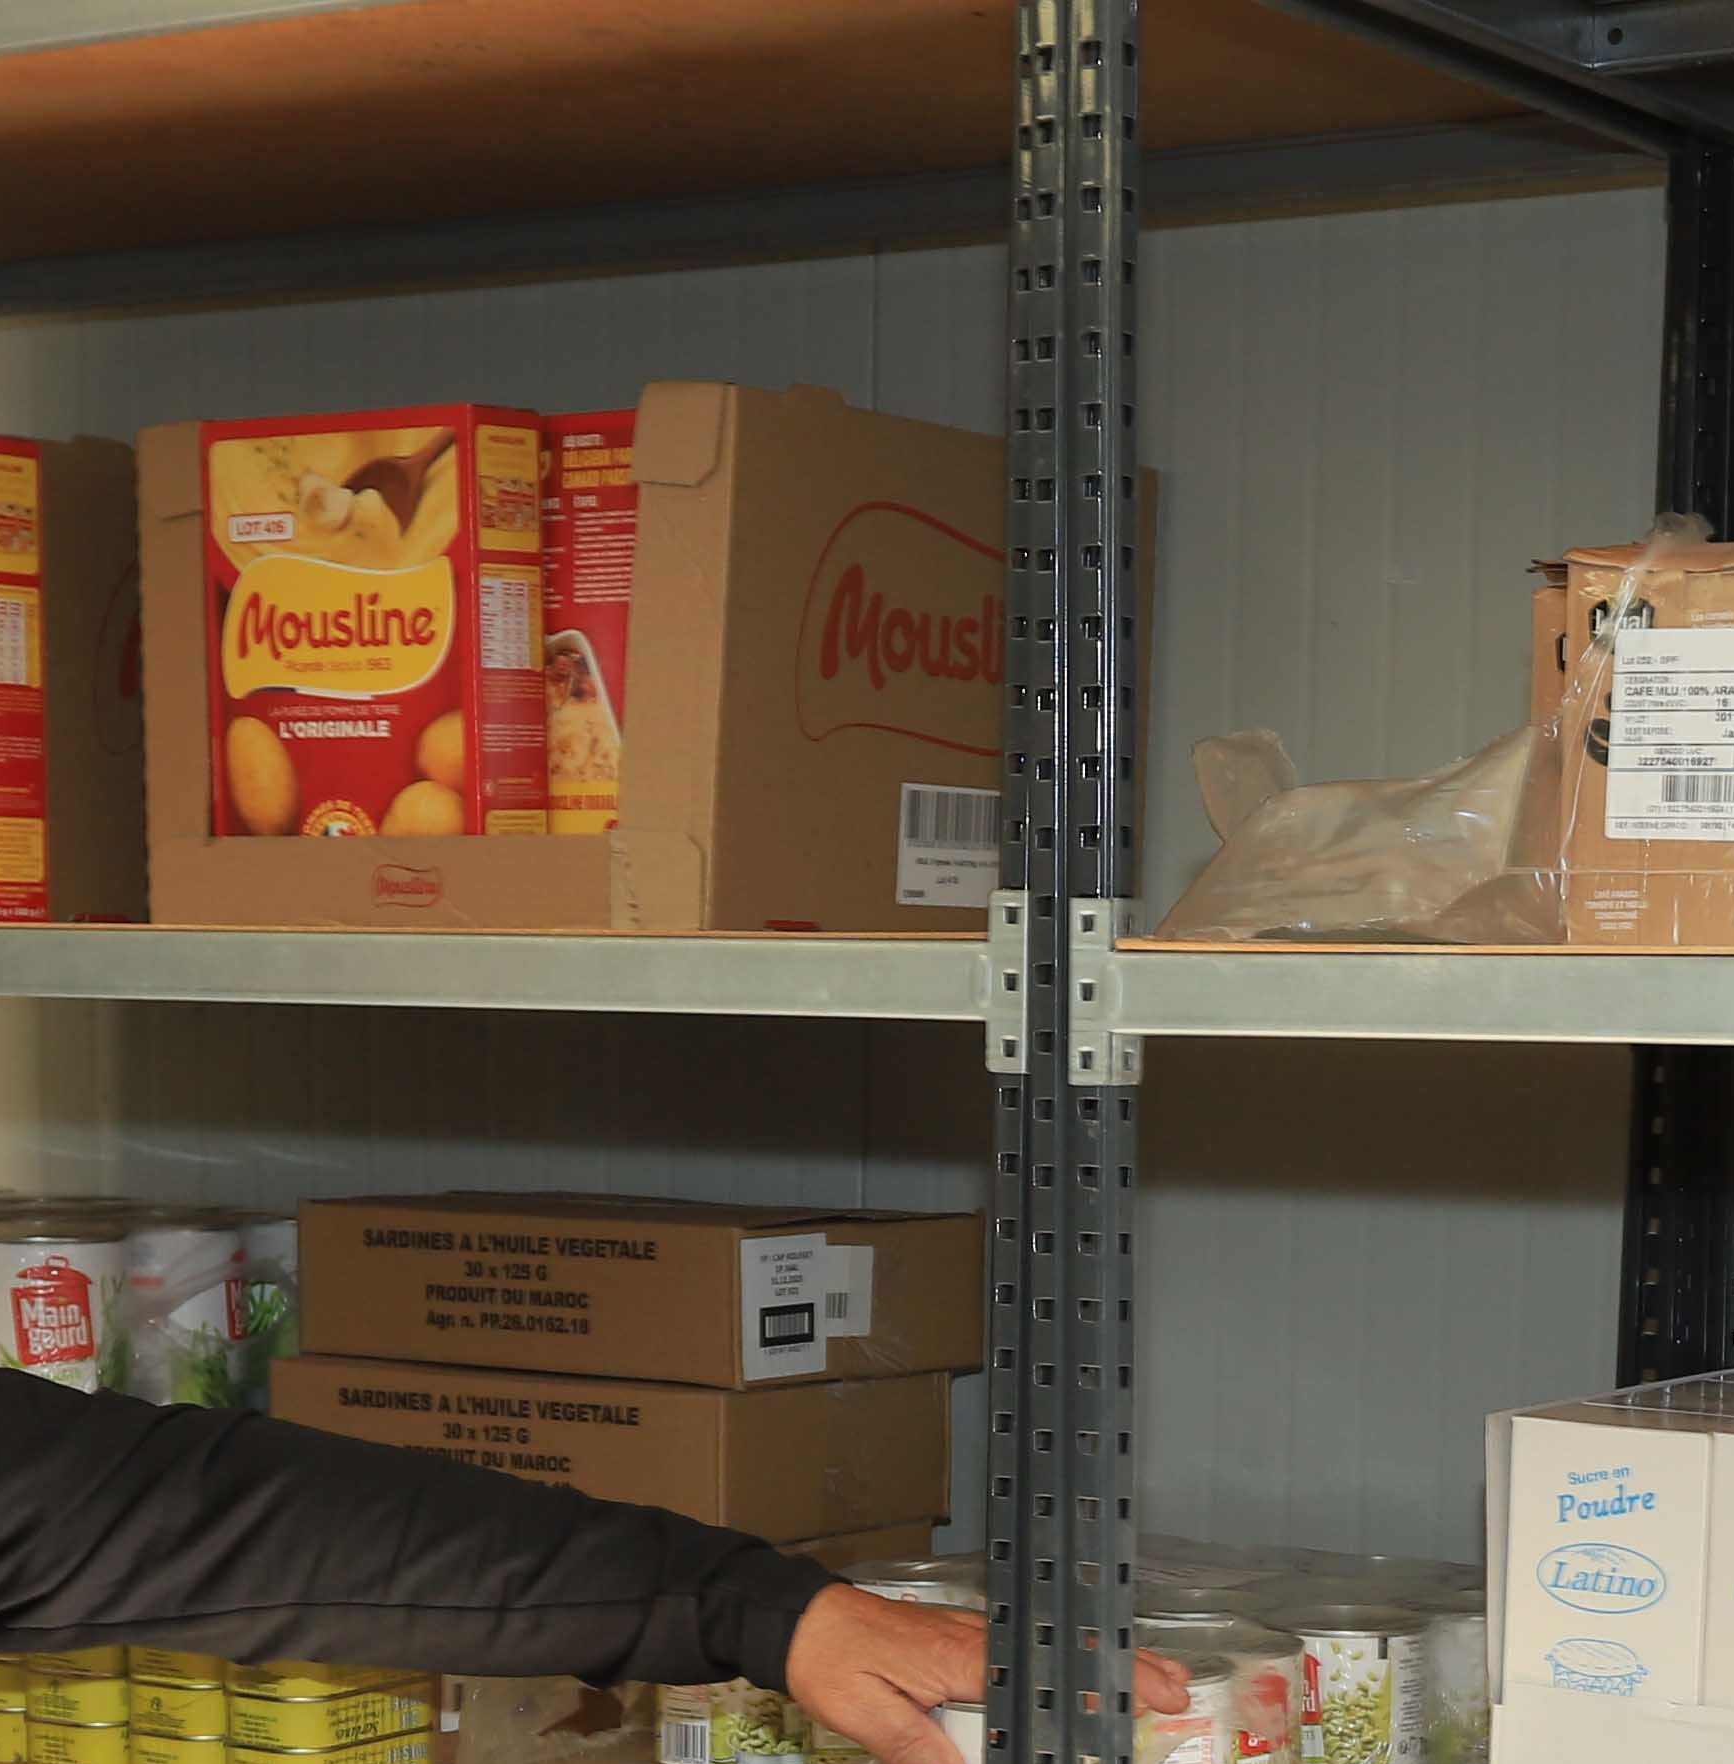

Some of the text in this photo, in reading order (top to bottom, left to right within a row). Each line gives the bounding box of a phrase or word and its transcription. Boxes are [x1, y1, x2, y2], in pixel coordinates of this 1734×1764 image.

[235, 521, 261, 536] LOT
[237, 591, 436, 660] Mousline
[1624, 686, 1652, 696] CAFE
[1656, 686, 1678, 696] MLU
[279, 721, 391, 738] L'ORIGINALE
[363, 1229, 657, 1260] SARDINES A L'HUILE VEGETALE
[464, 1261, 547, 1281] 30 x 125 G
[426, 1285, 588, 1308] PRODUIT DU MAROC
[19, 1298, 81, 1329] Main
[338, 1387, 640, 1426] SARDINES A L'HUILE VEGETALE
[443, 1423, 529, 1444] 30 x 125 G
[510, 1453, 571, 1472] MAROC
[1568, 1466, 1630, 1485] Sucre en
[1557, 1484, 1656, 1523] Poudre
[1547, 1560, 1656, 1598] Latino
